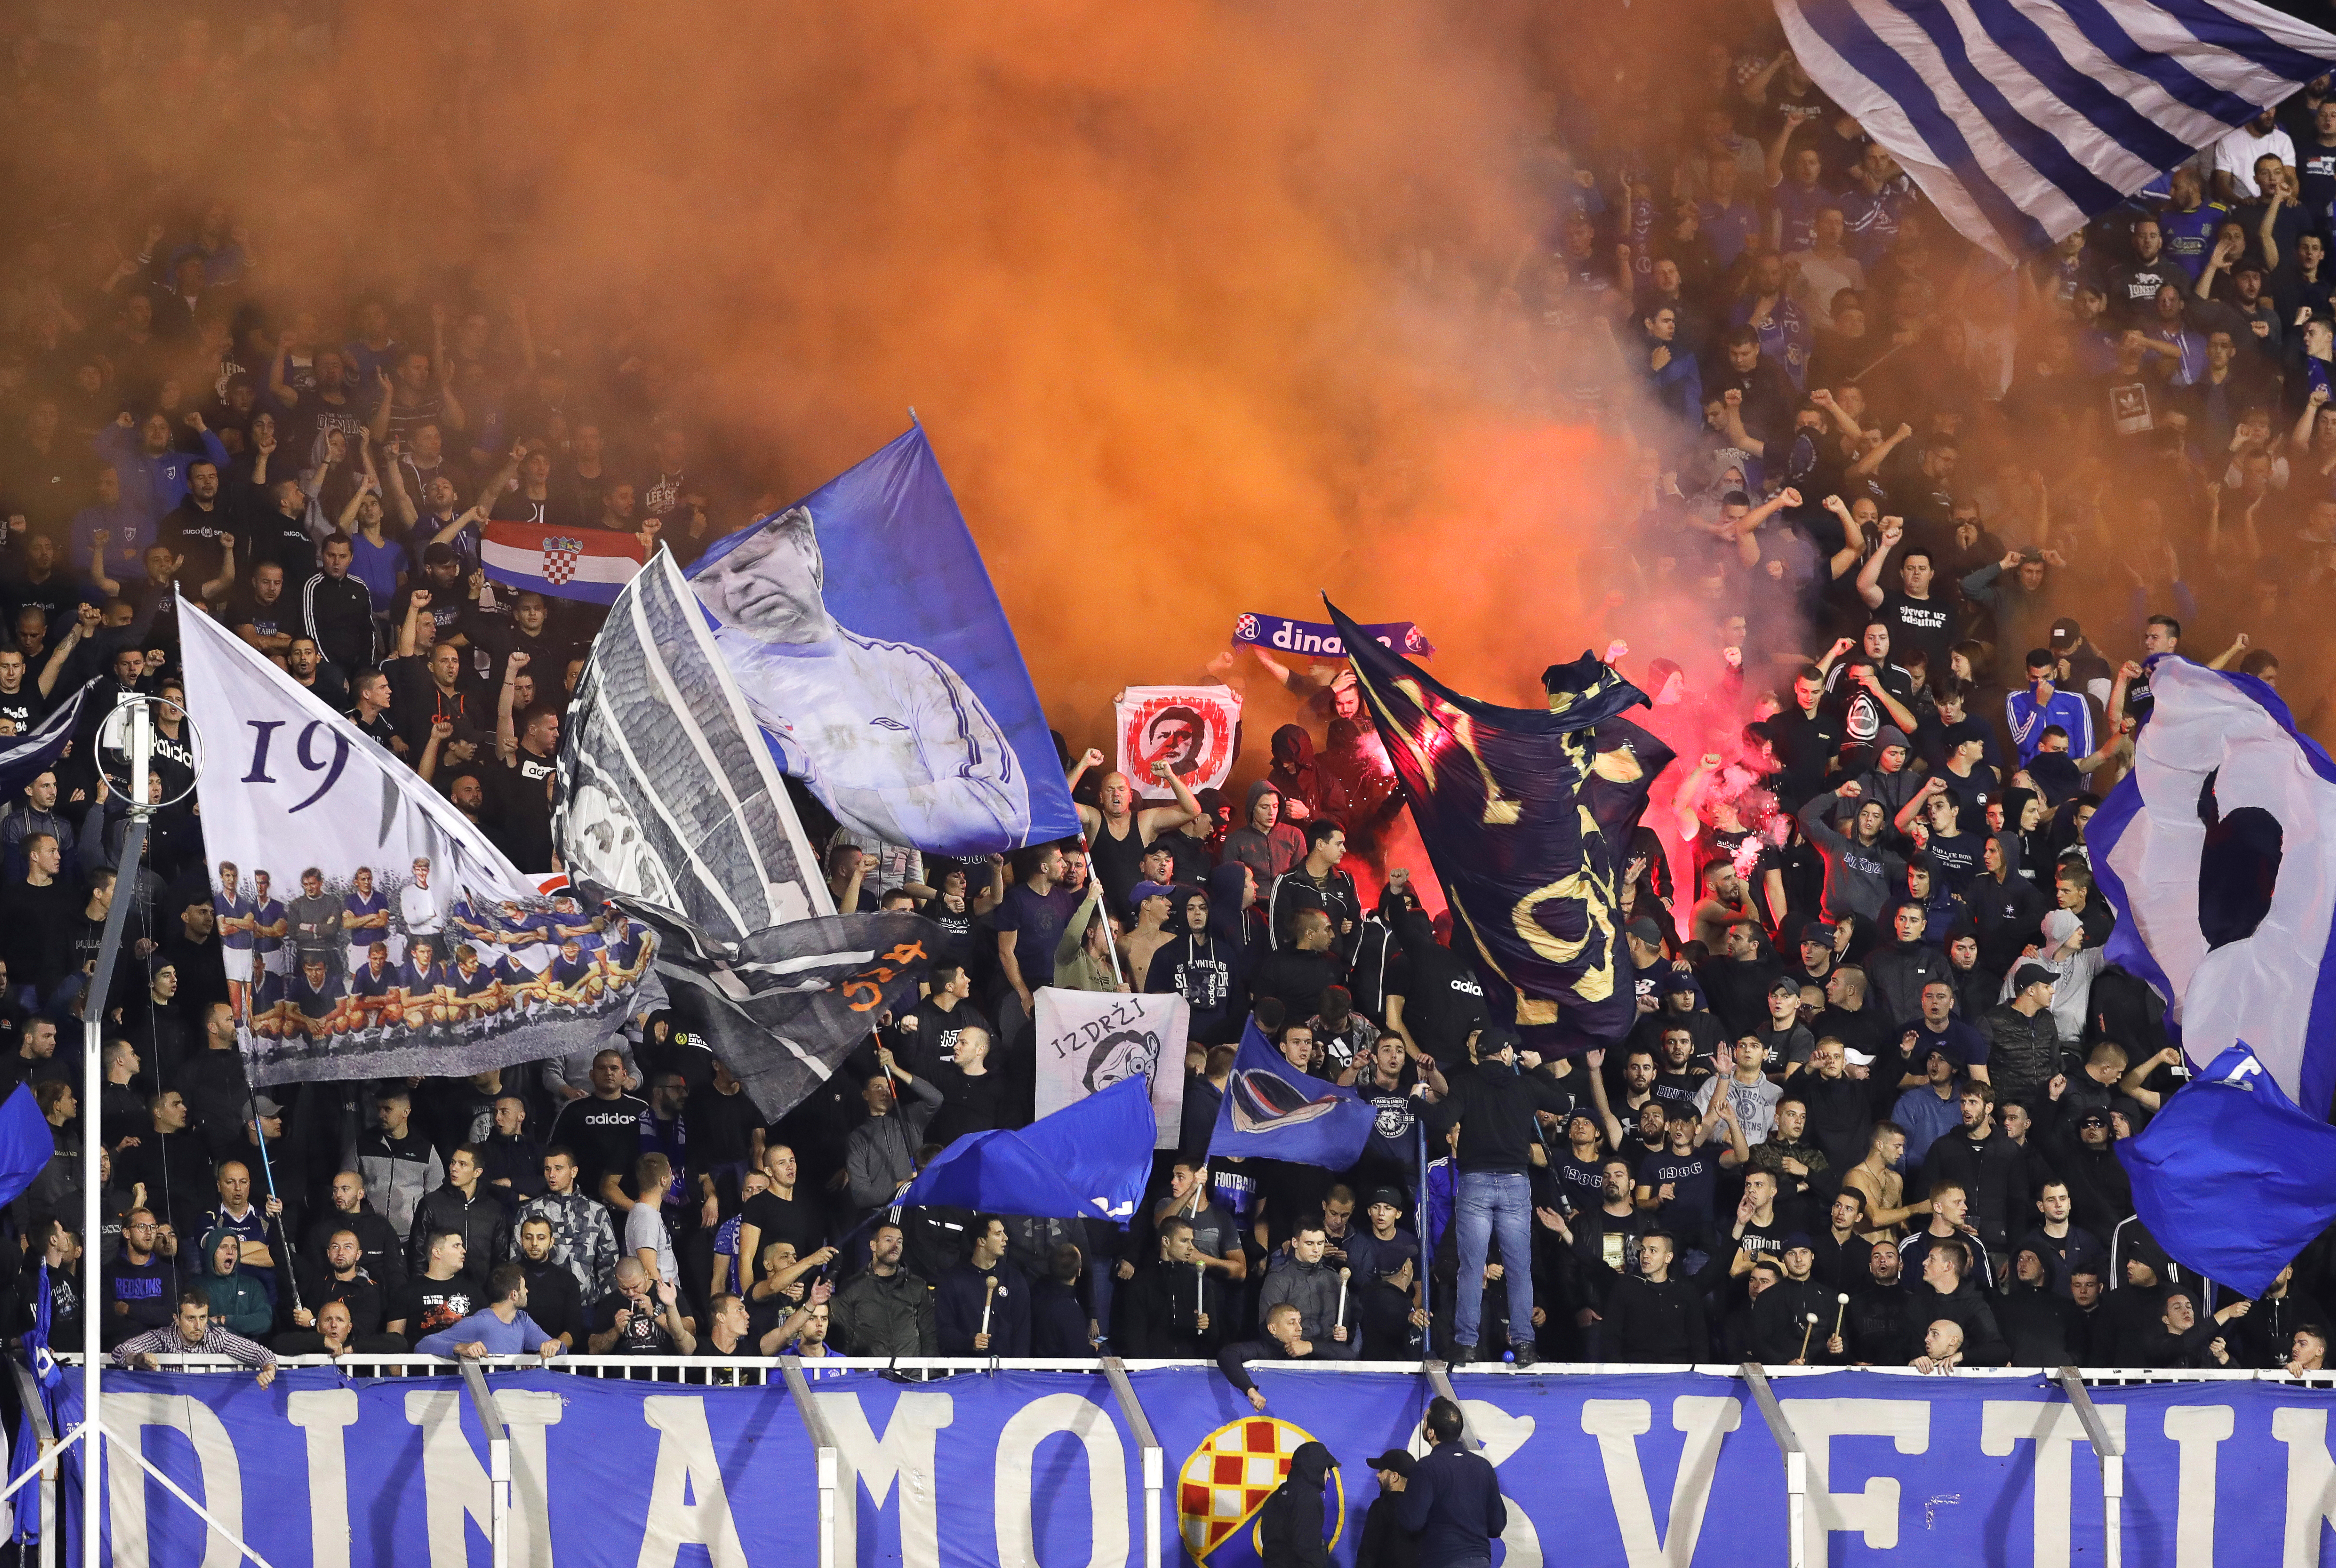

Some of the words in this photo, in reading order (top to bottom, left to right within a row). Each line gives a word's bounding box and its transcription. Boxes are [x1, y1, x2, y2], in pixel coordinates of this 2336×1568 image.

[1900, 606, 1930, 618] sjever
[1933, 612, 1946, 621] uz
[1901, 615, 1943, 628] odsutne
[1272, 621, 1392, 654] dinao
[16, 721, 27, 732] 86
[154, 733, 192, 769] dida
[1208, 973, 1216, 1006] adidas
[1451, 980, 1484, 997] adid
[1051, 998, 1149, 1059] IZDRŽI
[585, 1113, 636, 1125] adidas
[1564, 1165, 1603, 1188] 1986
[1658, 1161, 1703, 1180] 1986
[1215, 1171, 1256, 1194] FOOTBALL
[116, 1278, 161, 1295] REDSKINS
[100, 1388, 1130, 1568] DINAMO
